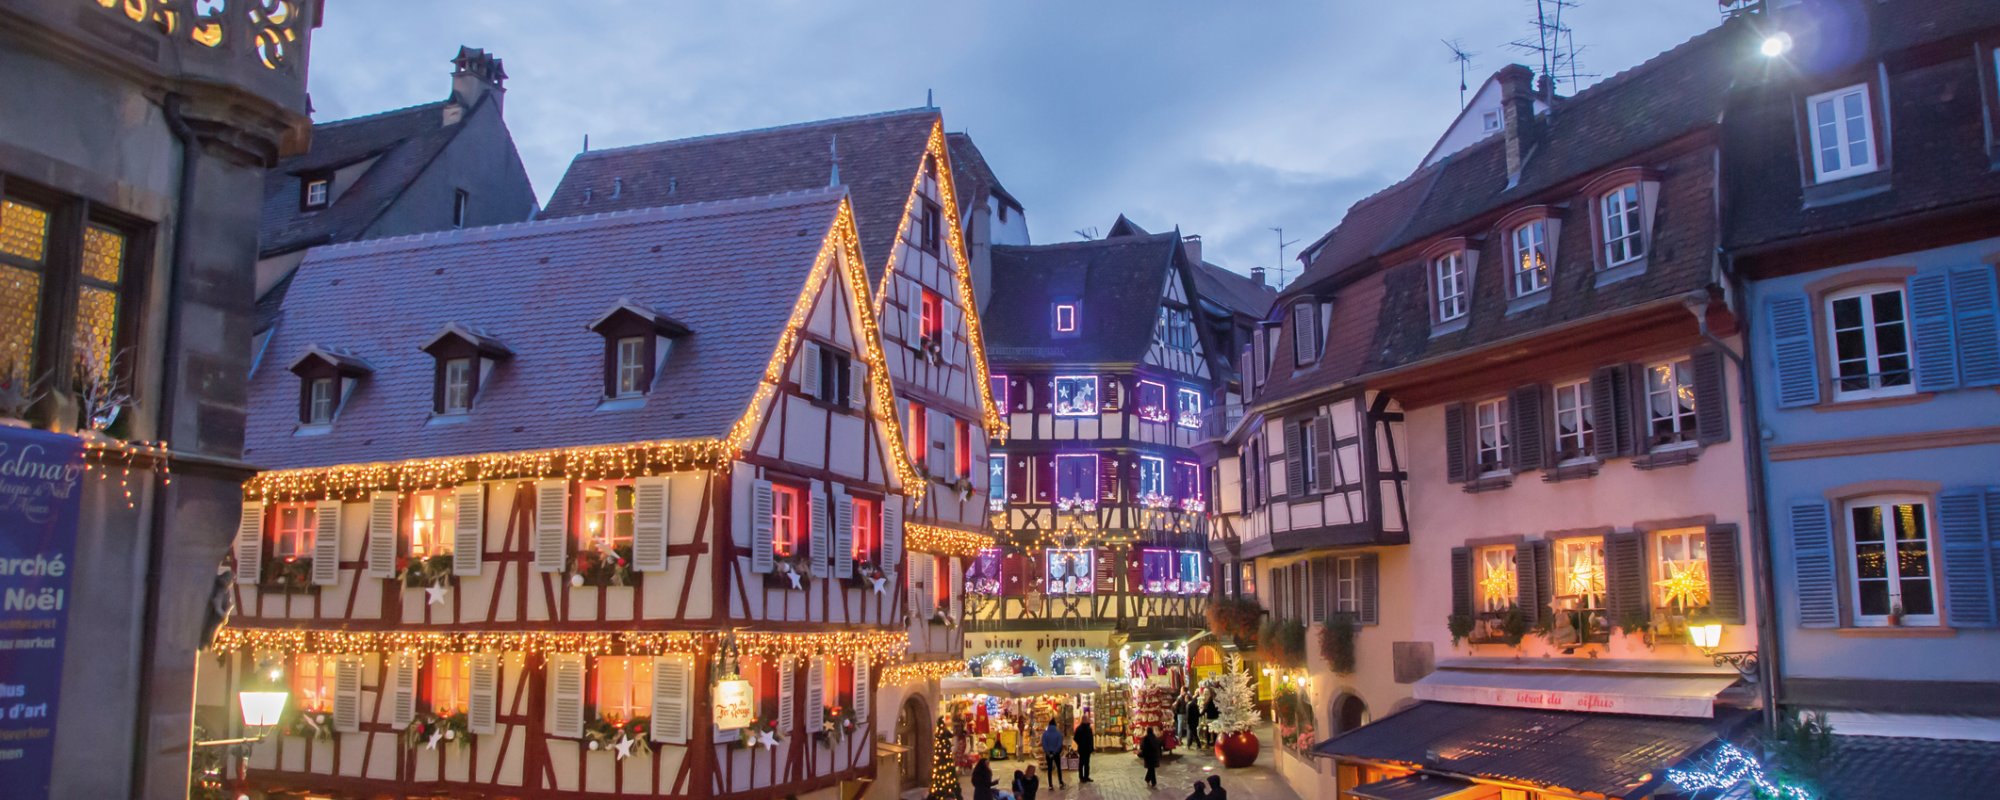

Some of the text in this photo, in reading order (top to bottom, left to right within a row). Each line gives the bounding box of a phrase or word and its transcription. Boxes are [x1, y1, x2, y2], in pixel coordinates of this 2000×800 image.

[4, 587, 65, 611] Noël
[1037, 633, 1086, 652] pignon
[1547, 692, 1562, 706] du
[9, 702, 47, 719] d'art
